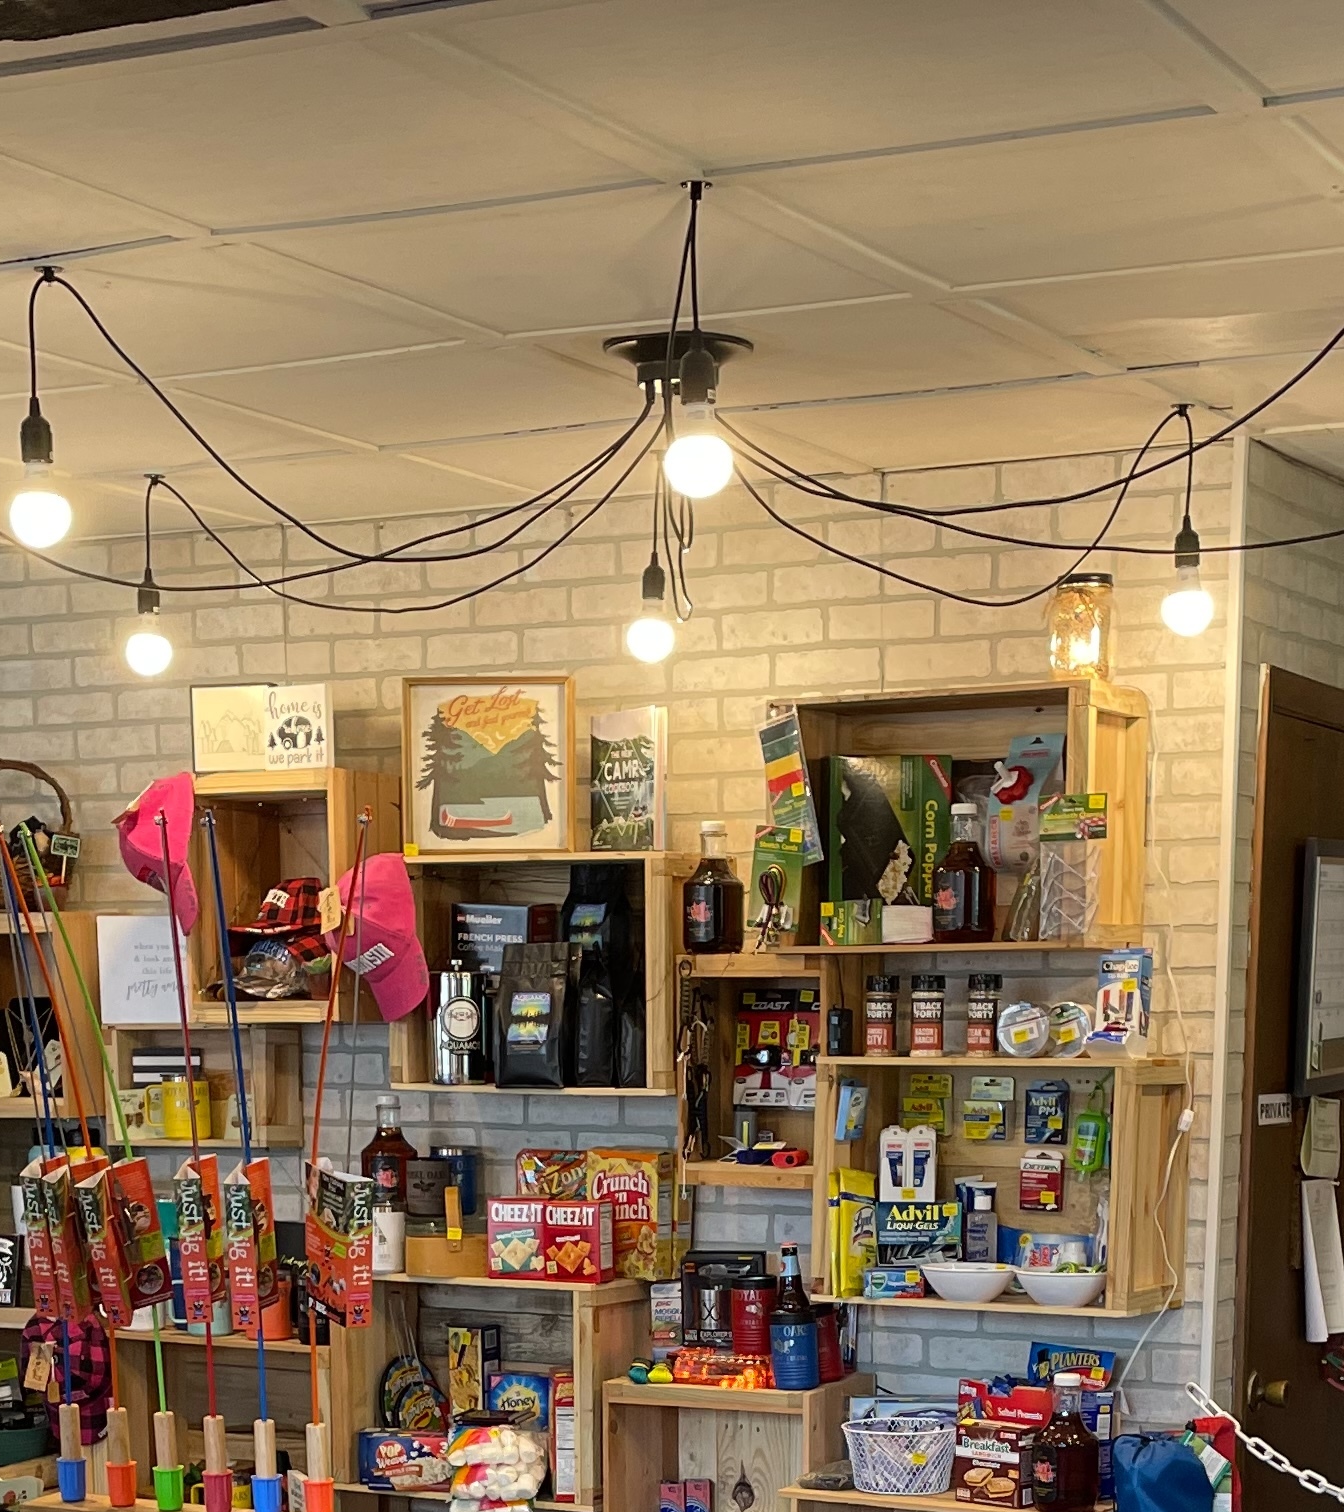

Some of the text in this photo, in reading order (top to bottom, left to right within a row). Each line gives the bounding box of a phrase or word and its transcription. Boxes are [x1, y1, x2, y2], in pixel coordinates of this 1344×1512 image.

[265, 691, 322, 719] home is
[443, 685, 527, 729] Get Lost
[268, 746, 325, 768] we park it
[603, 759, 641, 781] CAMP
[924, 799, 939, 839] Corn
[921, 842, 938, 900] Popper
[465, 913, 504, 926] Mueller
[457, 932, 524, 944] FRENCH PRESS
[751, 1001, 790, 1011] COAST
[909, 1102, 933, 1112] Advil
[1028, 1096, 1056, 1107] Advil
[1259, 1102, 1291, 1119] PRIVATE
[1037, 1106, 1057, 1116] PM
[592, 1170, 648, 1200] Crunch
[23, 1177, 44, 1222] Just
[79, 1188, 104, 1232] Just
[885, 1204, 942, 1221] Advil
[177, 1179, 208, 1284] Just jig it!
[225, 1184, 256, 1288] Just jig it!
[347, 1182, 372, 1287] Just jig it!
[1050, 1351, 1100, 1369] PLANTERS
[501, 1393, 537, 1411] Honey
[997, 1407, 1044, 1421] Salted Peanuts
[379, 1445, 404, 1457] POP
[962, 1436, 1012, 1454] Breakfast
